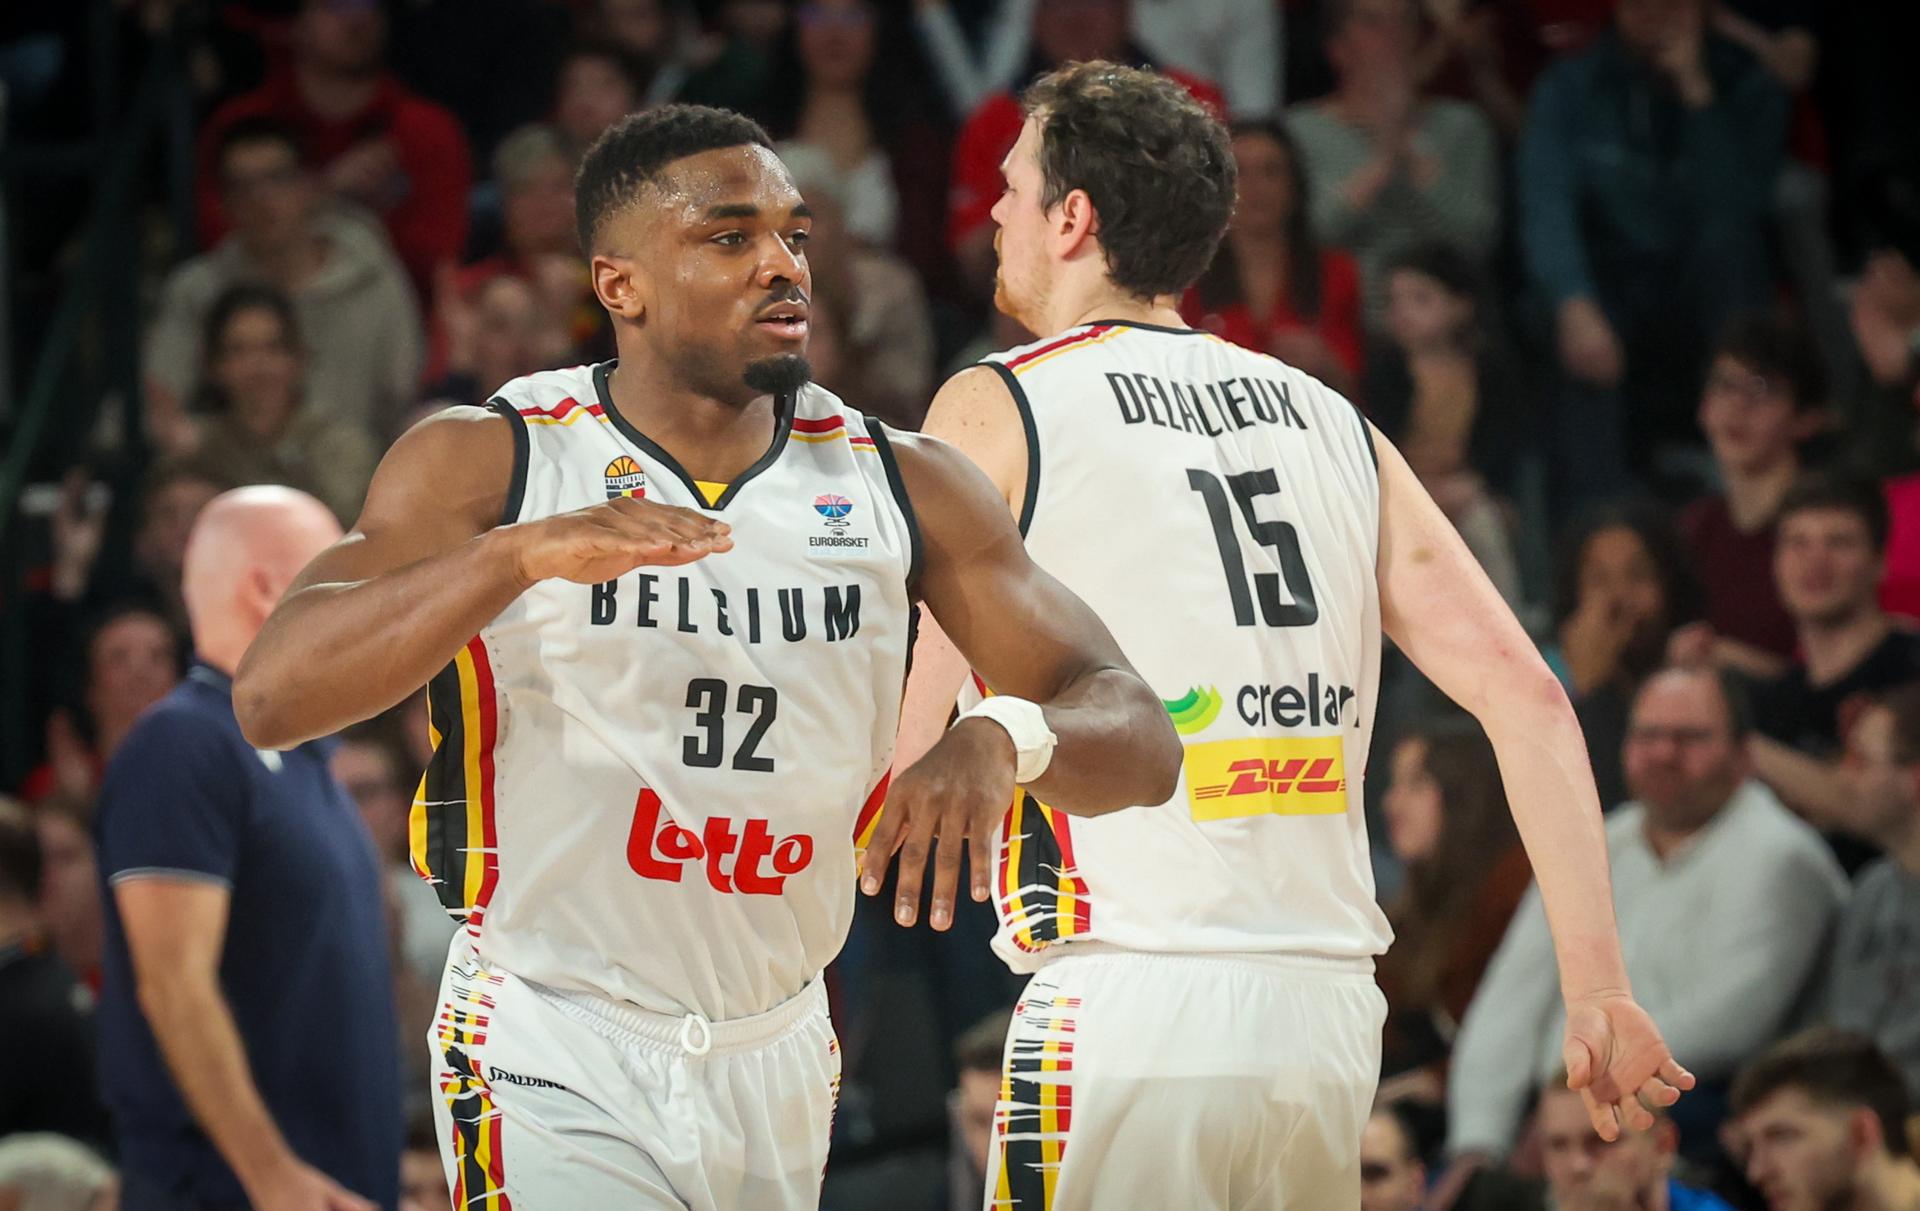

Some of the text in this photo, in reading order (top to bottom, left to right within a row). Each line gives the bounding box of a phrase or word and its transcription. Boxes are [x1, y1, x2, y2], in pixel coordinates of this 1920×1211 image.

[1105, 372, 1308, 438] DELALIEUX
[808, 536, 869, 548] EUROBASKET
[1185, 468, 1319, 628] 15
[590, 574, 861, 644] BELGIUM
[682, 678, 778, 772] 32
[1226, 758, 1335, 797] DHL
[626, 787, 814, 896] Lotto
[488, 1066, 566, 1090] SPALDING
